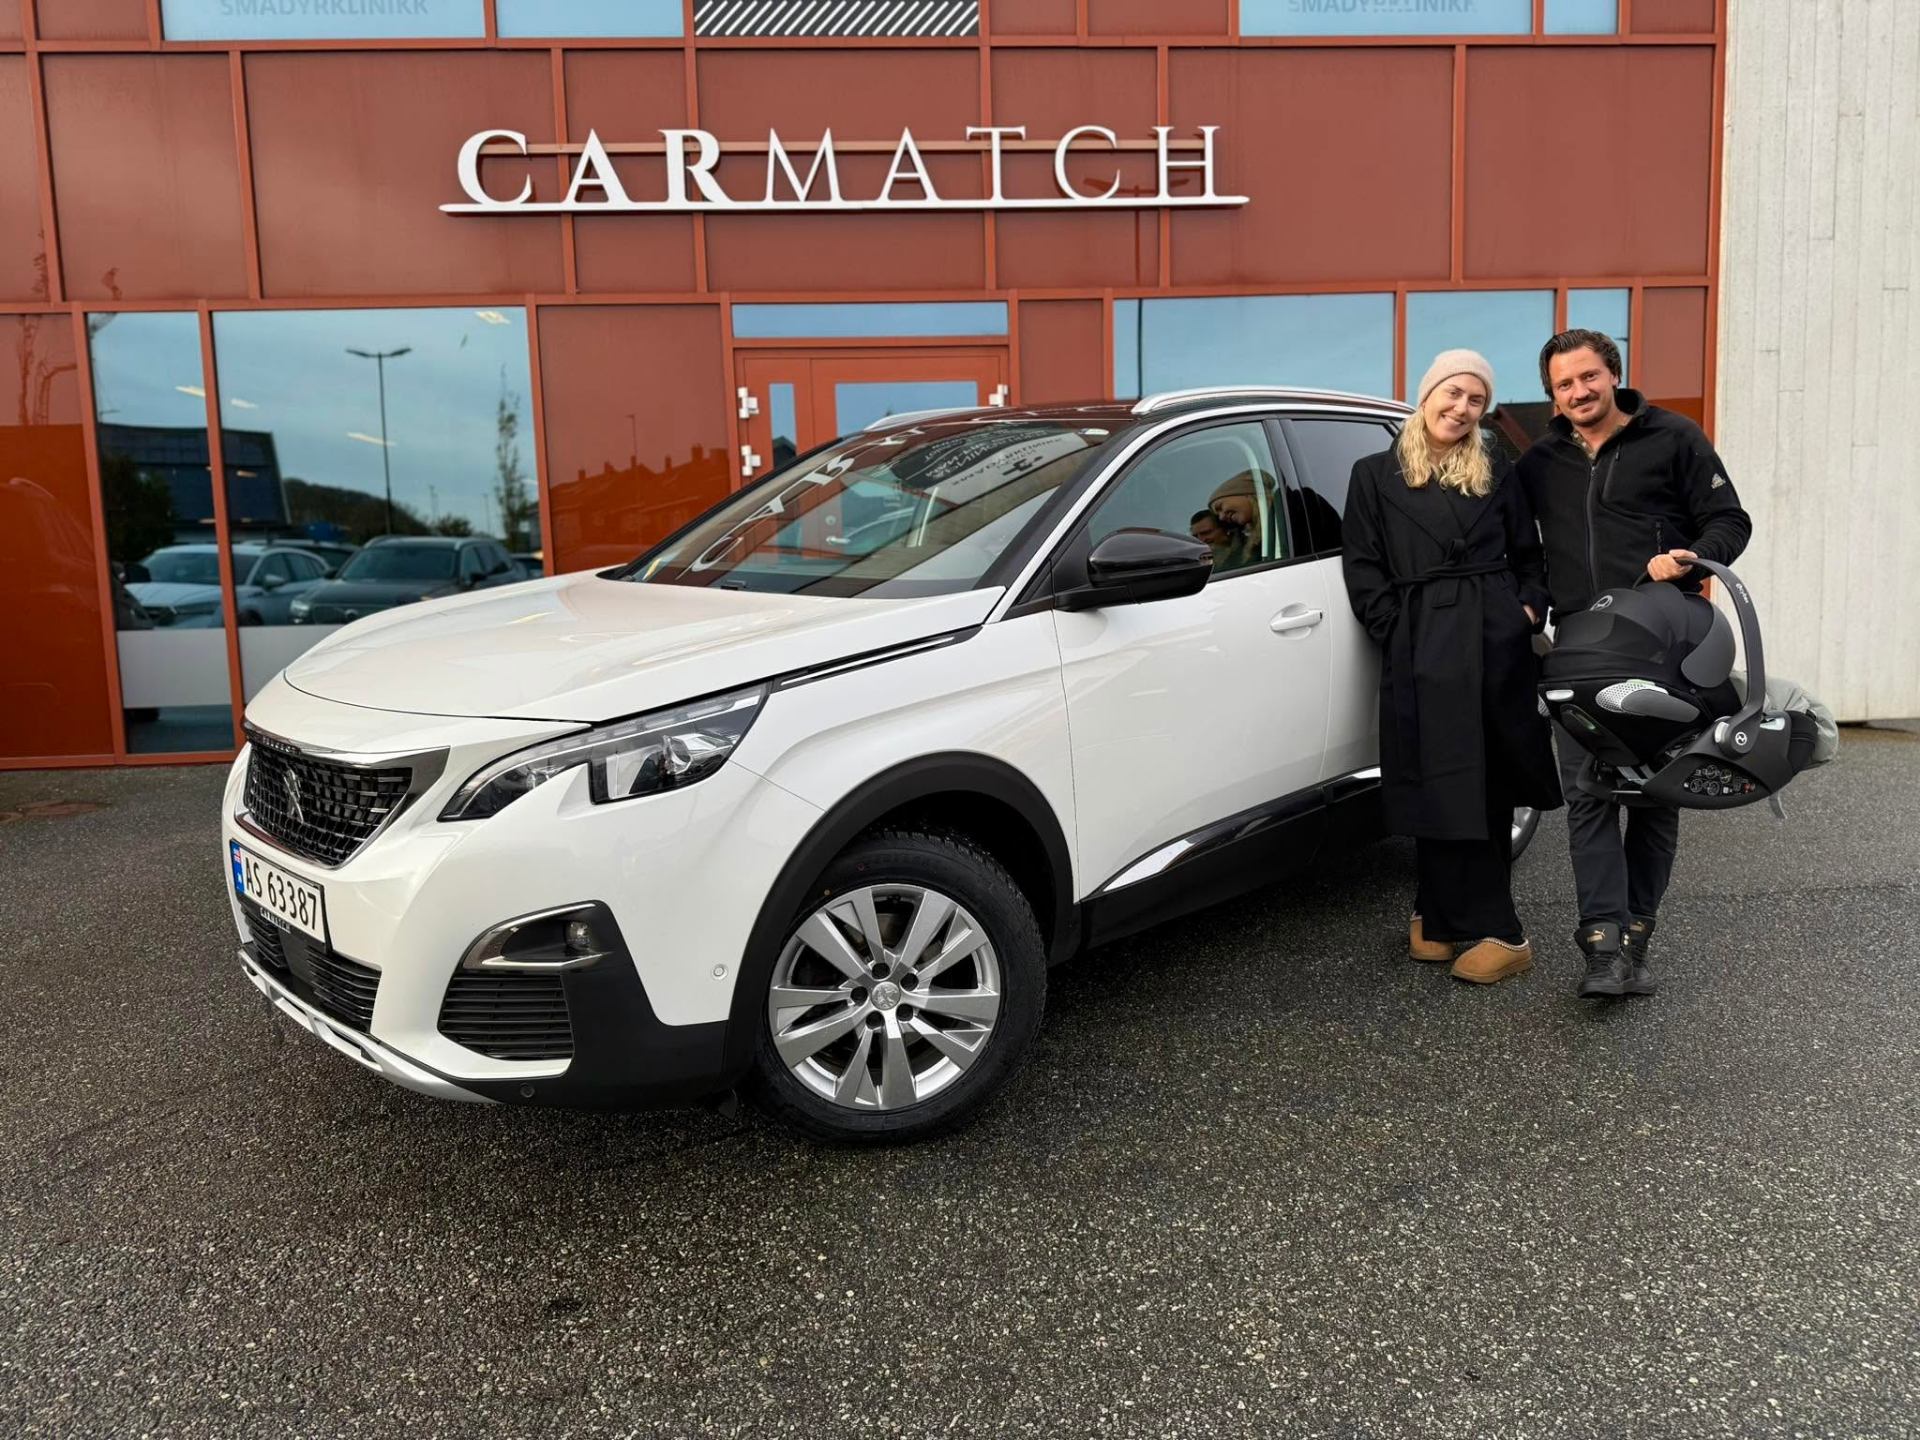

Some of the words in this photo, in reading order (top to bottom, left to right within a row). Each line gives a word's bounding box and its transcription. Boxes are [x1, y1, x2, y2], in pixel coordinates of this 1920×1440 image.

[457, 124, 1220, 206] CARMATCH
[245, 857, 262, 898] AS
[267, 871, 317, 931] 63387
